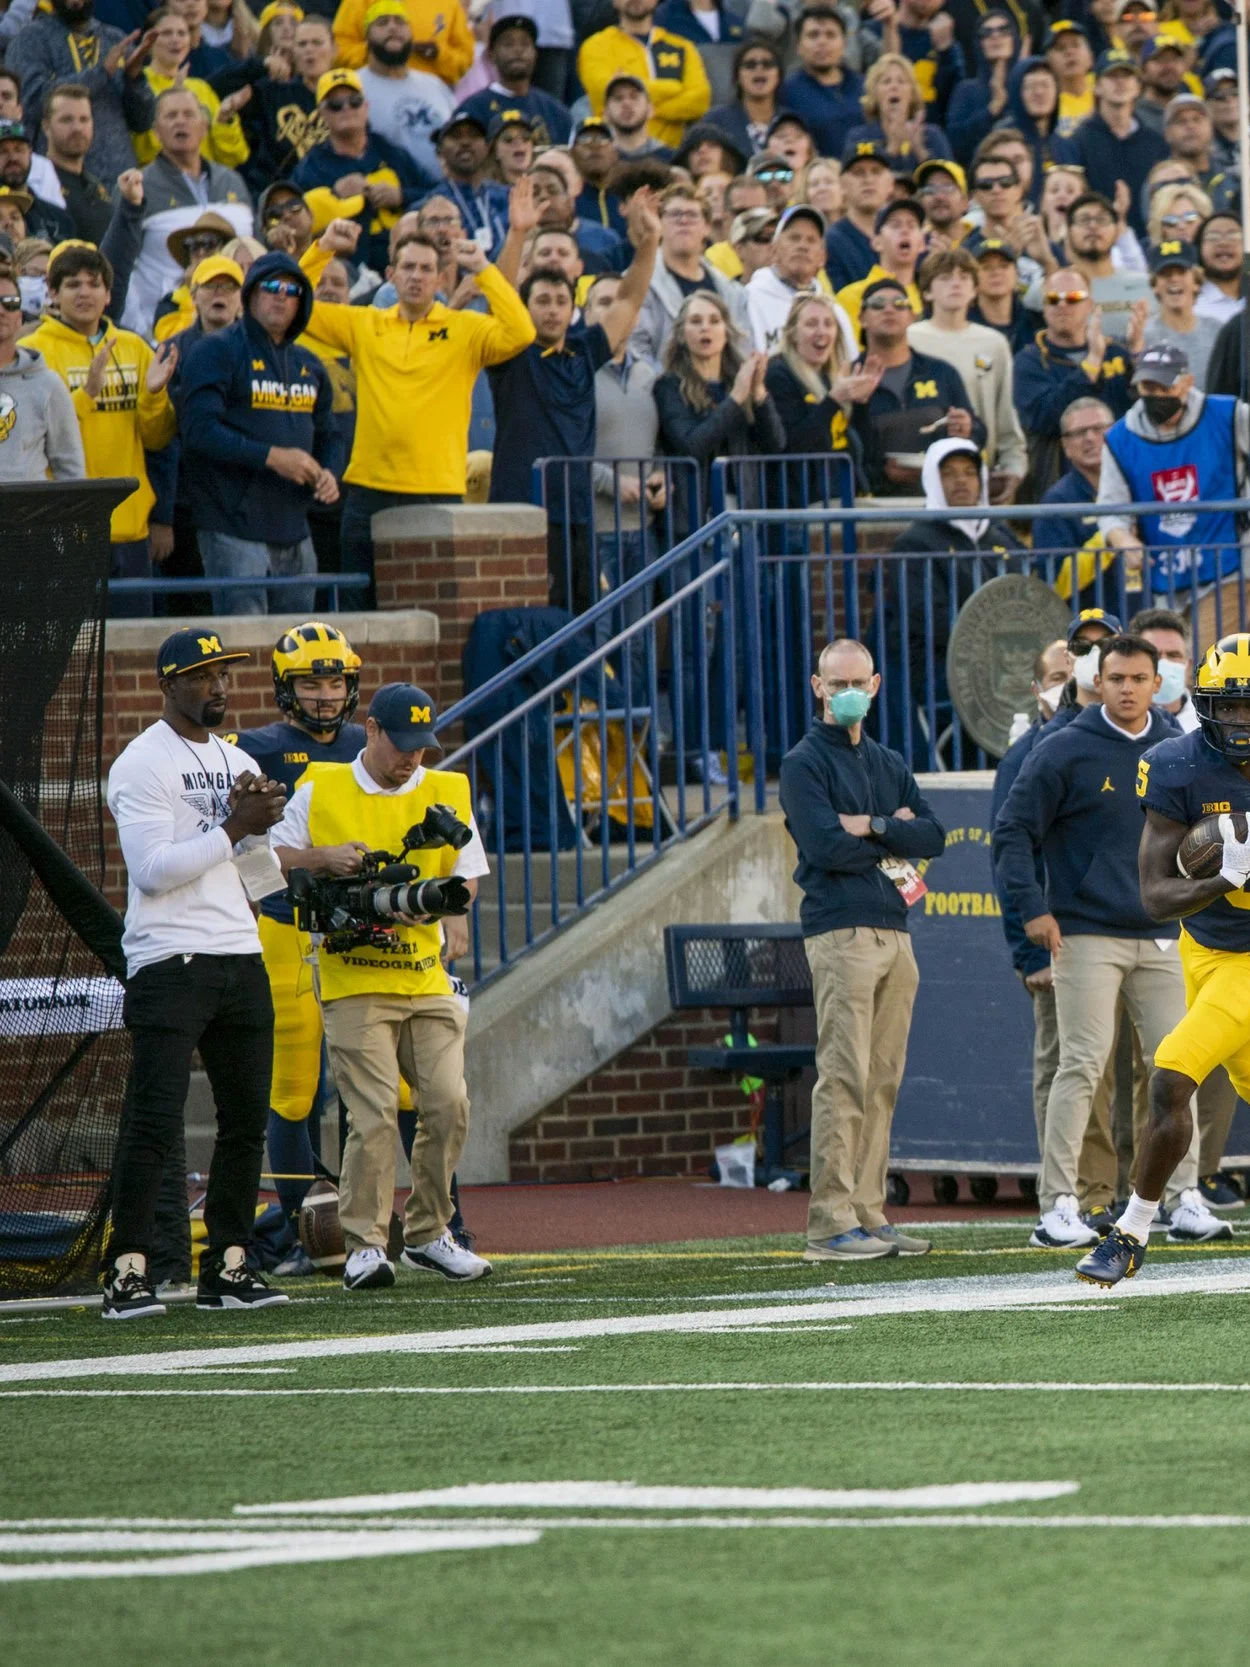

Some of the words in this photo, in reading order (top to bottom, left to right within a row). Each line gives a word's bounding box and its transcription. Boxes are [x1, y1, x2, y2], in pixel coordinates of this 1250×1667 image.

[428, 328, 448, 341] M
[914, 380, 939, 399] M
[197, 635, 222, 655] M
[1237, 678, 1248, 686] M
[410, 706, 431, 723] M
[181, 772, 240, 791] MICHGA
[1136, 759, 1150, 798] 5
